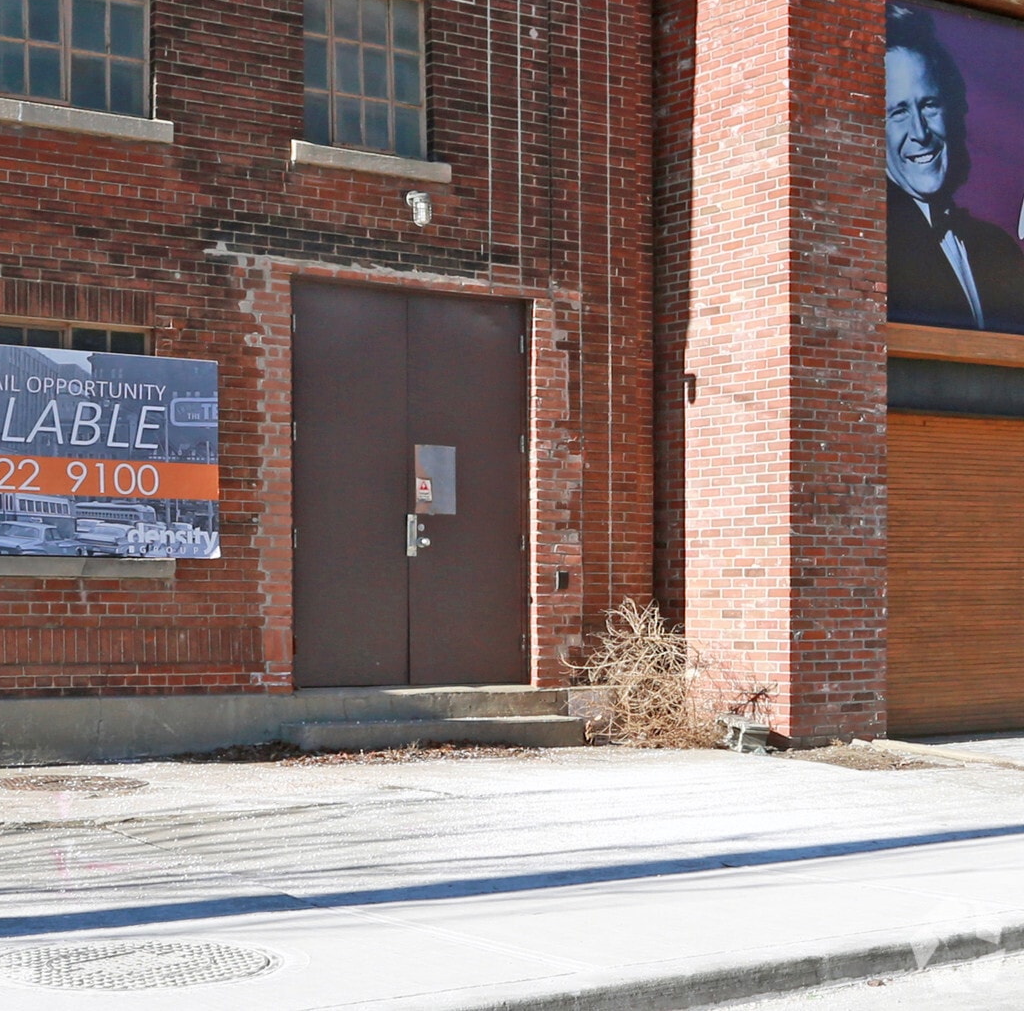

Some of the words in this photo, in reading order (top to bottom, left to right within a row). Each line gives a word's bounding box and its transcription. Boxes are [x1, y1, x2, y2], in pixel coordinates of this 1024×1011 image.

[26, 376, 167, 401] OPPORTUNITY
[66, 460, 160, 496] 9100
[127, 522, 219, 555] density
[139, 546, 200, 555] GROUP
